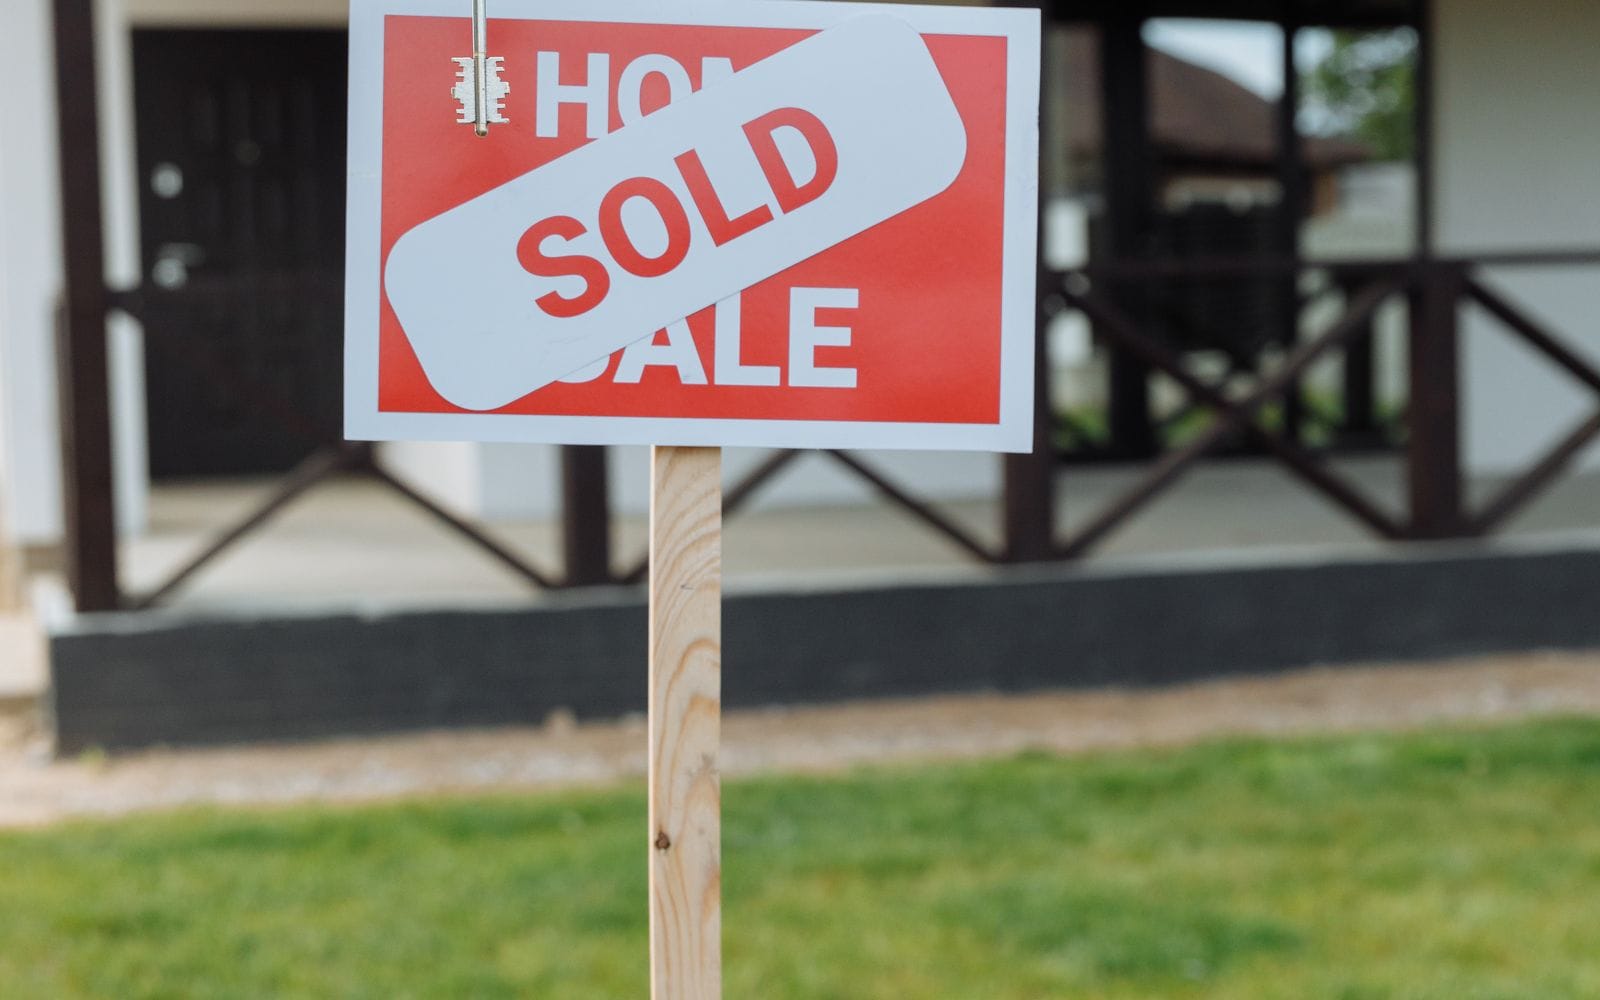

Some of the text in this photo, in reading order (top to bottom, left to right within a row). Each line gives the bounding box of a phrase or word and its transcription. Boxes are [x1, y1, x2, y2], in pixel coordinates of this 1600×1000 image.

[535, 51, 735, 139] HO
[516, 107, 838, 318] SOLD
[556, 286, 859, 388] ALE
